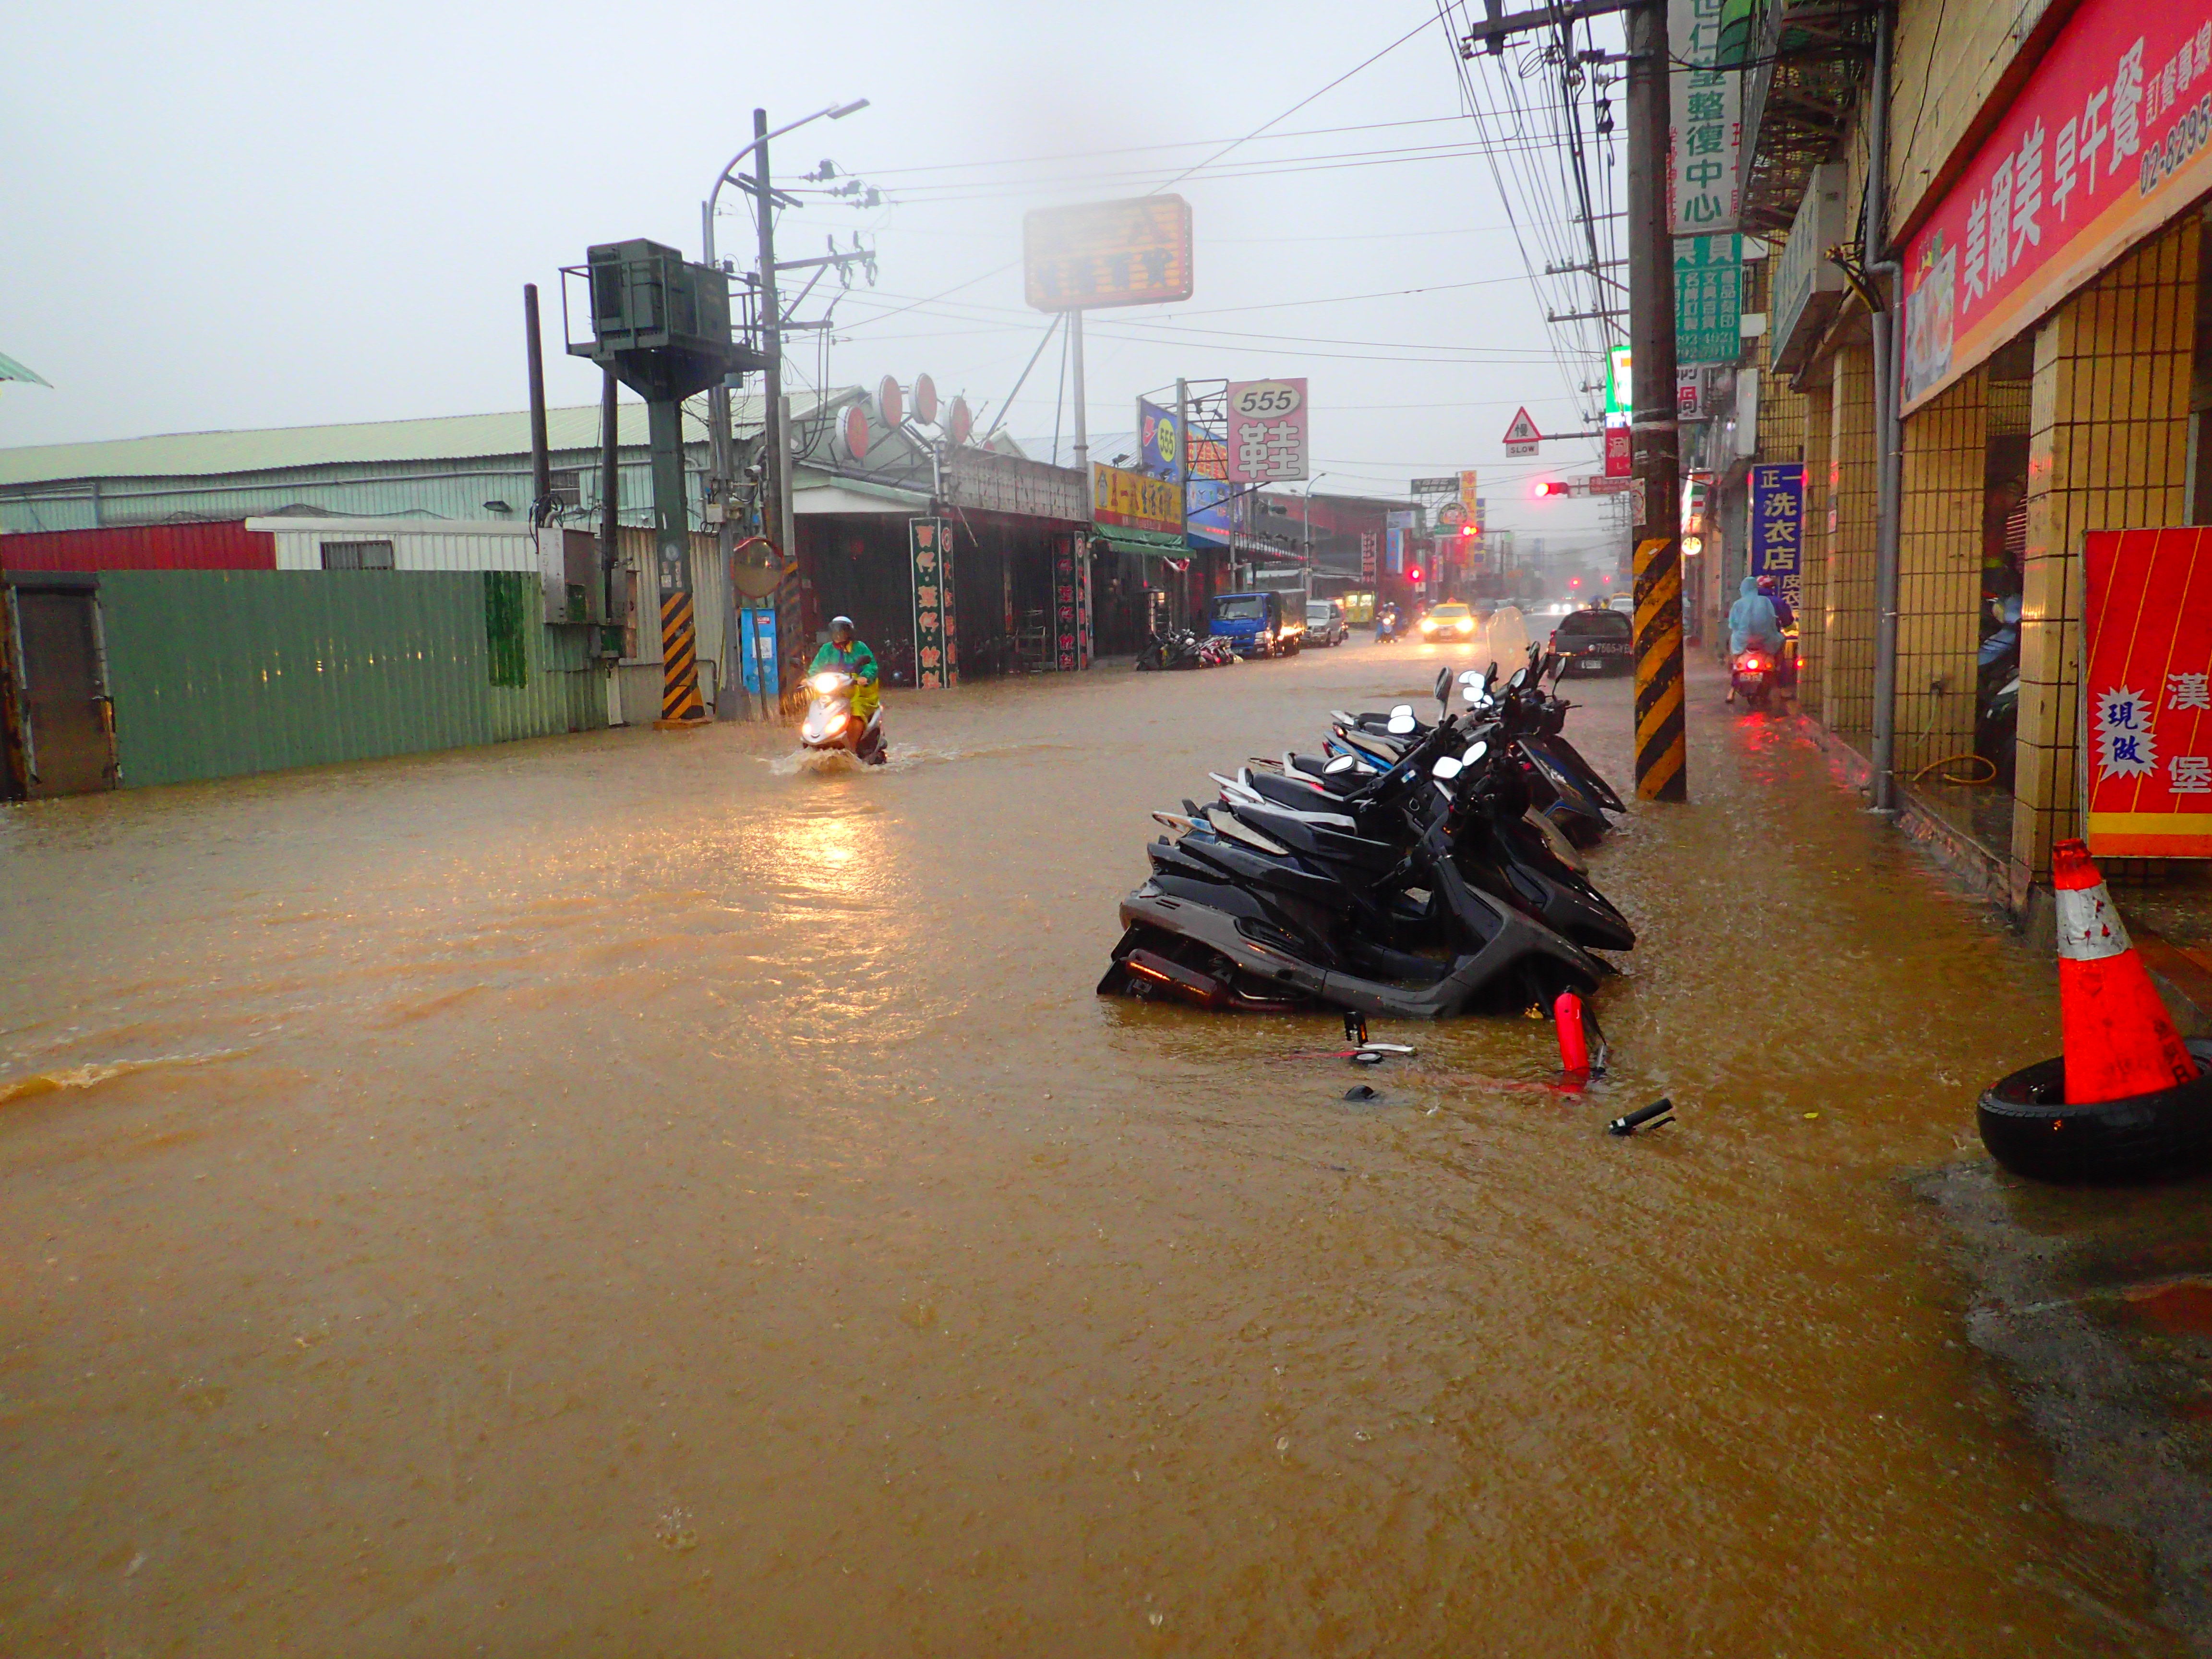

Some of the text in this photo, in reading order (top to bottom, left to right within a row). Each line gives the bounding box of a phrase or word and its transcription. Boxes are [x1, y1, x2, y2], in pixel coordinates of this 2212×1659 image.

[2145, 19, 2212, 128] 訂餐專線
[1962, 36, 2144, 314] 美爾美早午餐
[2140, 93, 2212, 199] 02-8295
[1241, 390, 1292, 411] 555
[1515, 423, 1528, 437] 慢
[1159, 427, 1174, 456] 555
[1238, 421, 1301, 479] 鞋
[1761, 469, 1803, 489] 正一
[1763, 492, 1798, 570] 洗衣店
[2108, 701, 2146, 764] 現做
[2166, 673, 2212, 793] 漢堡
